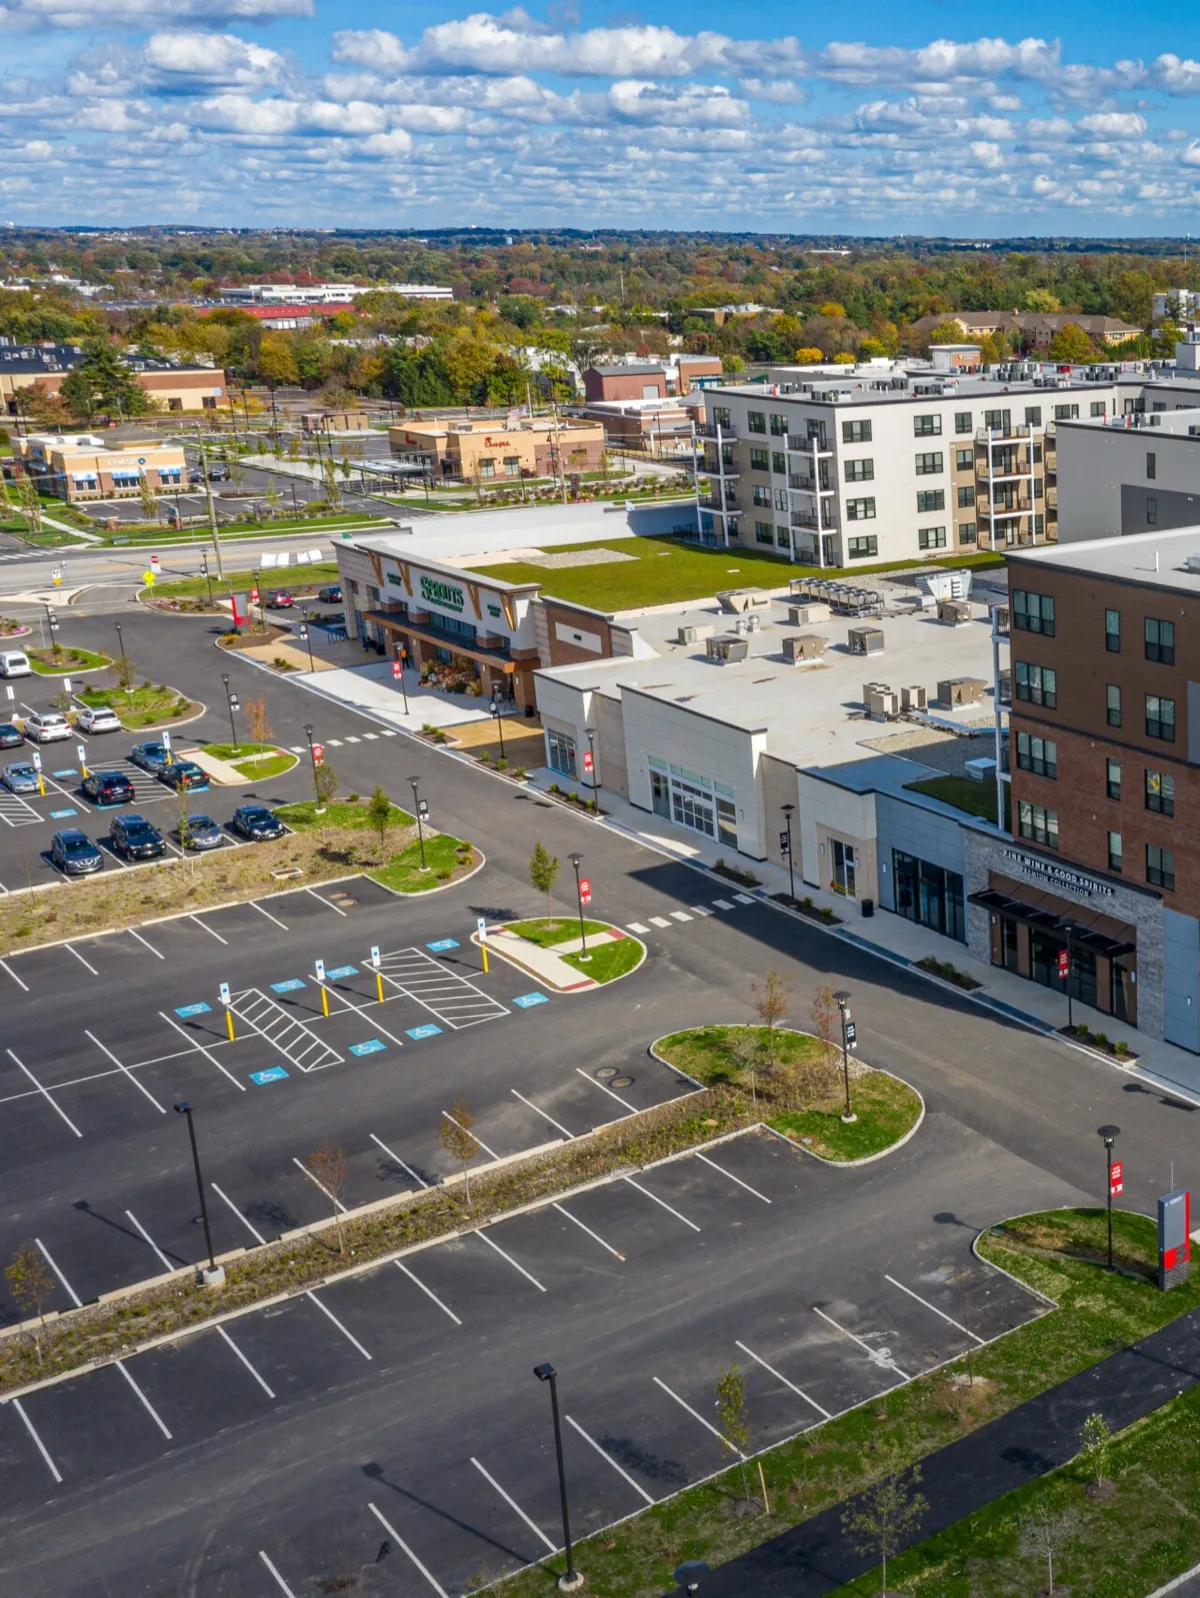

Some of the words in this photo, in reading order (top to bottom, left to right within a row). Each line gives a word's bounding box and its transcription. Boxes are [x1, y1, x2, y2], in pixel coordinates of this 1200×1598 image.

[420, 576, 464, 606] SPROUTS
[1003, 849, 1021, 862] FINE
[1024, 858, 1045, 871] WINE
[1054, 868, 1078, 883] GOOD
[1080, 878, 1113, 896] SPIRITS
[1020, 866, 1048, 881] PREMIUM
[1050, 878, 1089, 897] COLLECTION
